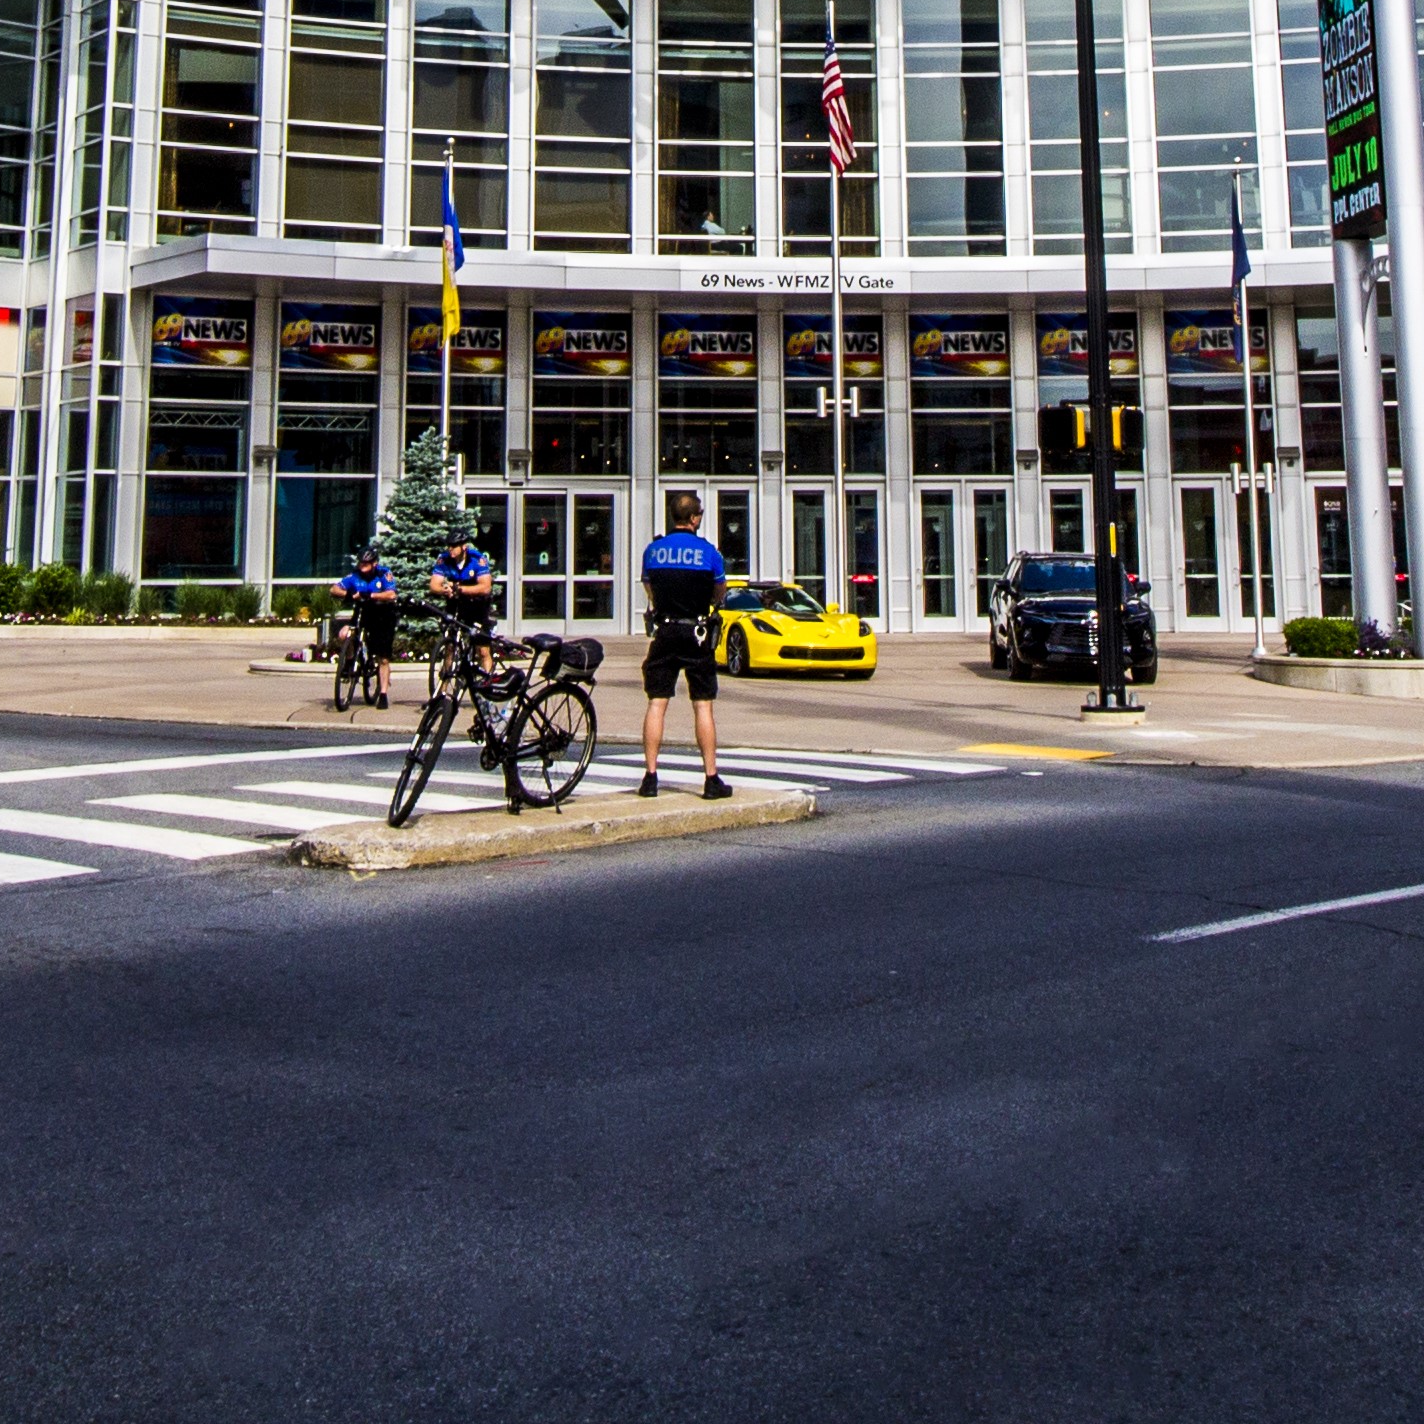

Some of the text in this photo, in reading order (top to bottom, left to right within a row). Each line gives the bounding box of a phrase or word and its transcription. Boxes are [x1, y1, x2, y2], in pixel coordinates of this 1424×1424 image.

[1322, 1, 1371, 73] ZOMBIE
[1324, 52, 1375, 121] MANSON
[1331, 136, 1378, 191] JULY 10
[1333, 182, 1382, 224] PPL CENTER
[700, 273, 720, 288] 69
[724, 274, 765, 288] News
[777, 275, 830, 289] WFMZ
[858, 274, 895, 289] Gate
[183, 318, 247, 341] NEWS
[312, 323, 375, 346] NEWS
[1200, 328, 1265, 350] NES
[565, 330, 627, 352] NEWS
[690, 332, 752, 353] NEWS
[816, 333, 879, 353] NWS
[943, 333, 1006, 353] NEWS
[1070, 331, 1134, 352] NWS
[649, 547, 704, 566] POLICE
